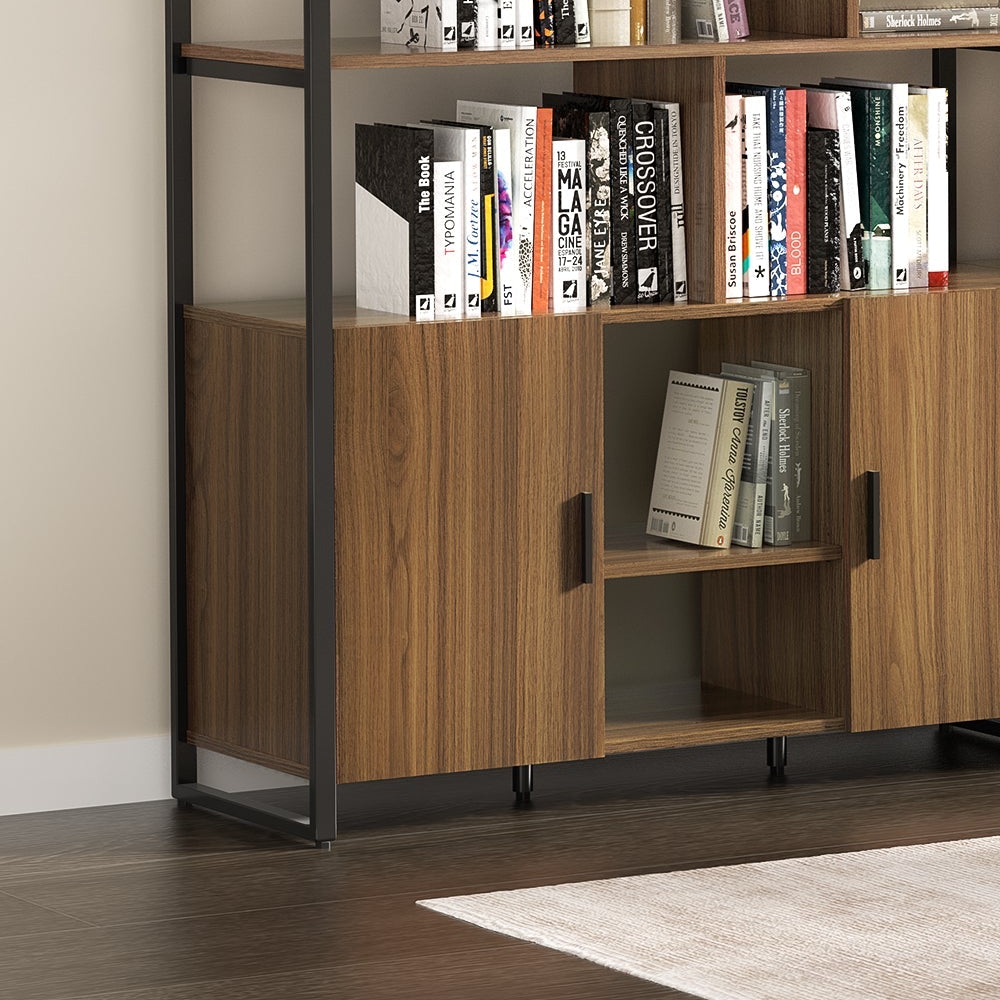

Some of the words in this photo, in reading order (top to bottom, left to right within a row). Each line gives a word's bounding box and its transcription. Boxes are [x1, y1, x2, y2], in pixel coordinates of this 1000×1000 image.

[886, 14, 915, 28] Sherlock
[917, 14, 942, 27] Holmes
[752, 113, 761, 129] TAKE
[896, 106, 905, 154] Freedom
[557, 150, 566, 161] 13
[617, 115, 627, 165] QUENCHED
[753, 132, 761, 150] THAT
[418, 155, 430, 186] Book
[524, 118, 535, 207] ACCELERATION
[619, 166, 628, 185] LIKE
[753, 152, 762, 185] NURSING
[634, 120, 658, 251] CROSSOVER
[754, 186, 762, 206] HOME
[896, 162, 907, 216] Machinery
[418, 191, 430, 214] The
[444, 170, 455, 255] TYPOMANIA
[558, 190, 583, 213] LA
[594, 199, 606, 235] EYRE
[620, 195, 629, 220] WICK
[754, 209, 763, 224] AND
[466, 199, 480, 246] Coetzee
[558, 213, 583, 236] GA
[728, 210, 737, 252] Briscoe
[754, 225, 763, 249] SHOVE
[467, 249, 479, 266] M.
[558, 236, 582, 249] CINE
[594, 240, 605, 275] JANE
[791, 231, 801, 276] BLOOD
[558, 256, 583, 266] 17-24
[728, 255, 737, 288] Susan
[732, 387, 749, 424] TOLSTOY
[778, 408, 790, 443] Sherlock
[728, 427, 742, 464] Anna
[778, 443, 790, 473] Holmes
[718, 468, 736, 530] Karenina
[754, 518, 762, 536] NAME
